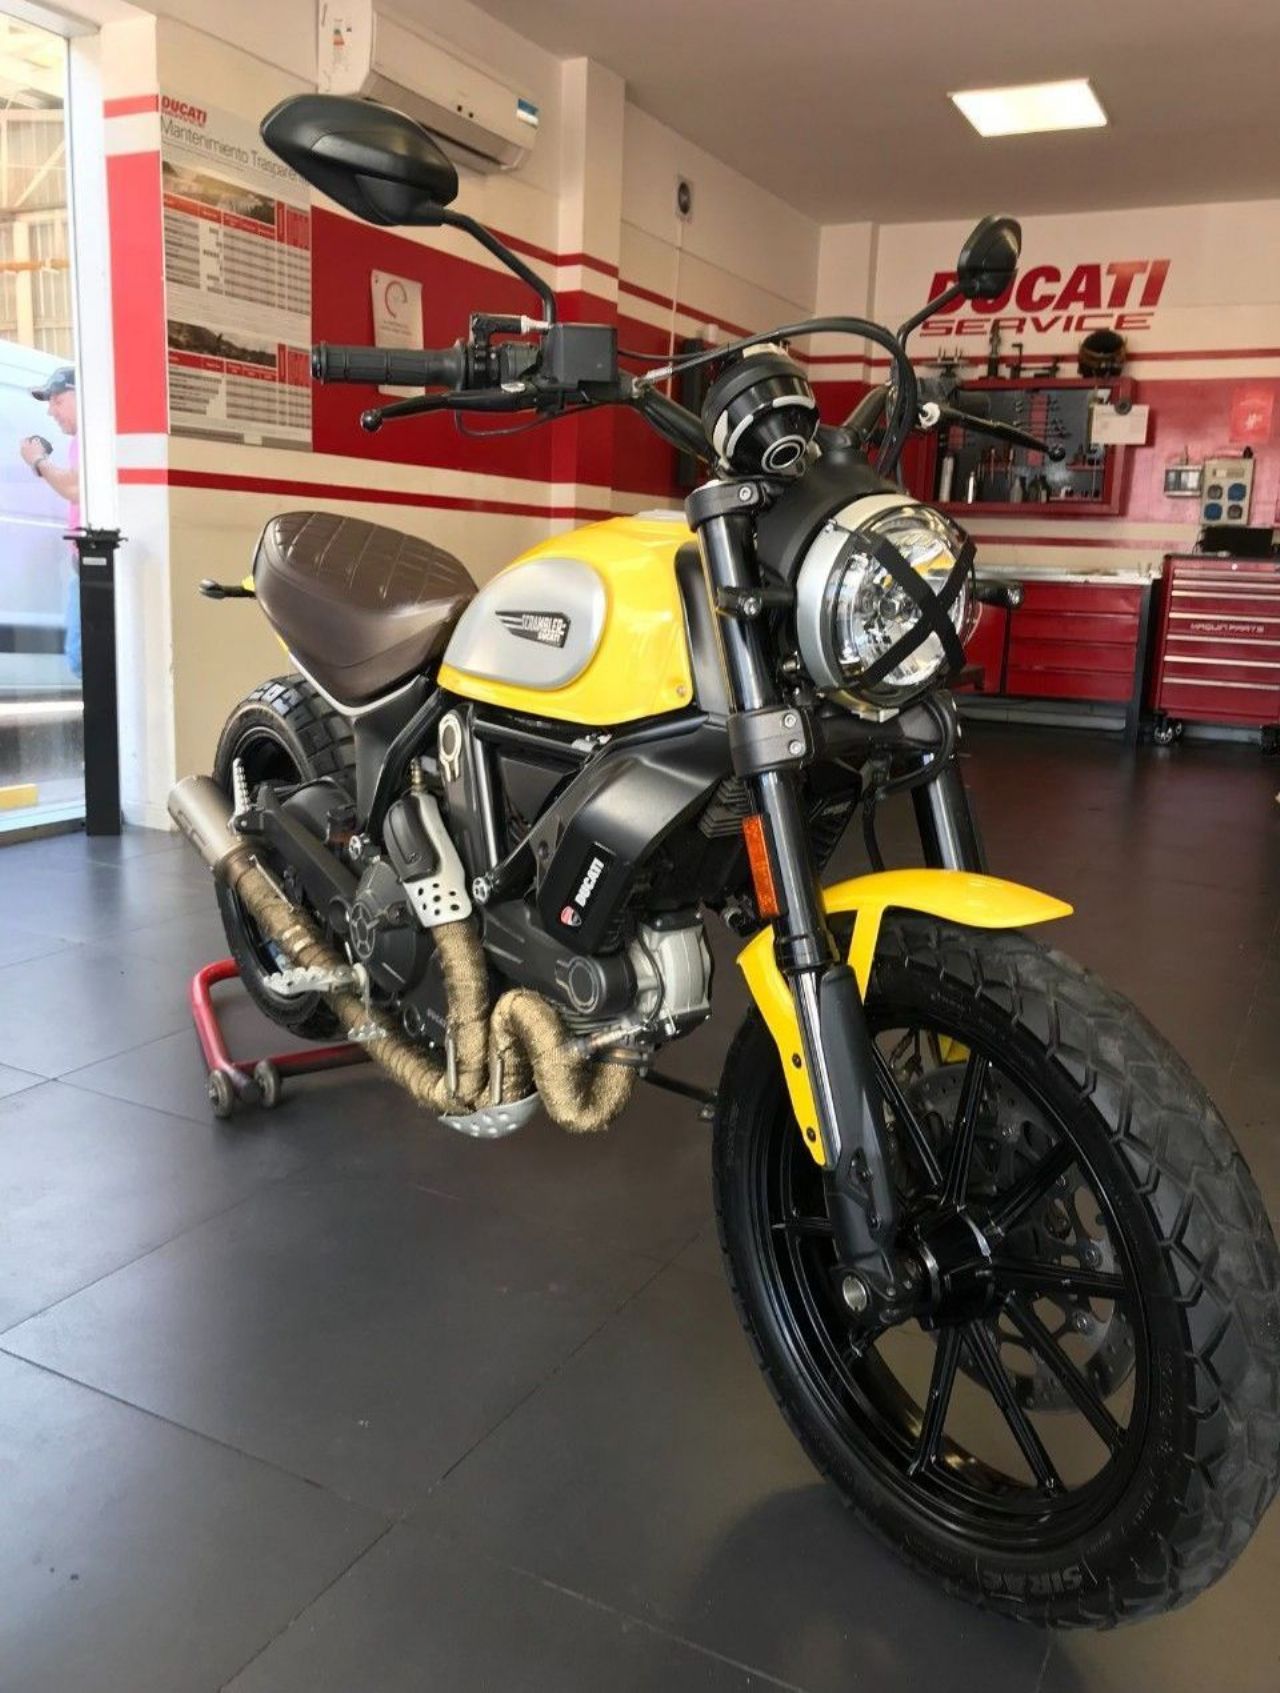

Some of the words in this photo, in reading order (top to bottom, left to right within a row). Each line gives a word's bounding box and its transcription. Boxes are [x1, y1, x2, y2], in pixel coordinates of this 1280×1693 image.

[161, 95, 207, 123] DUCATI
[919, 312, 1155, 338] SERVICE
[574, 857, 605, 908] DUCATI
